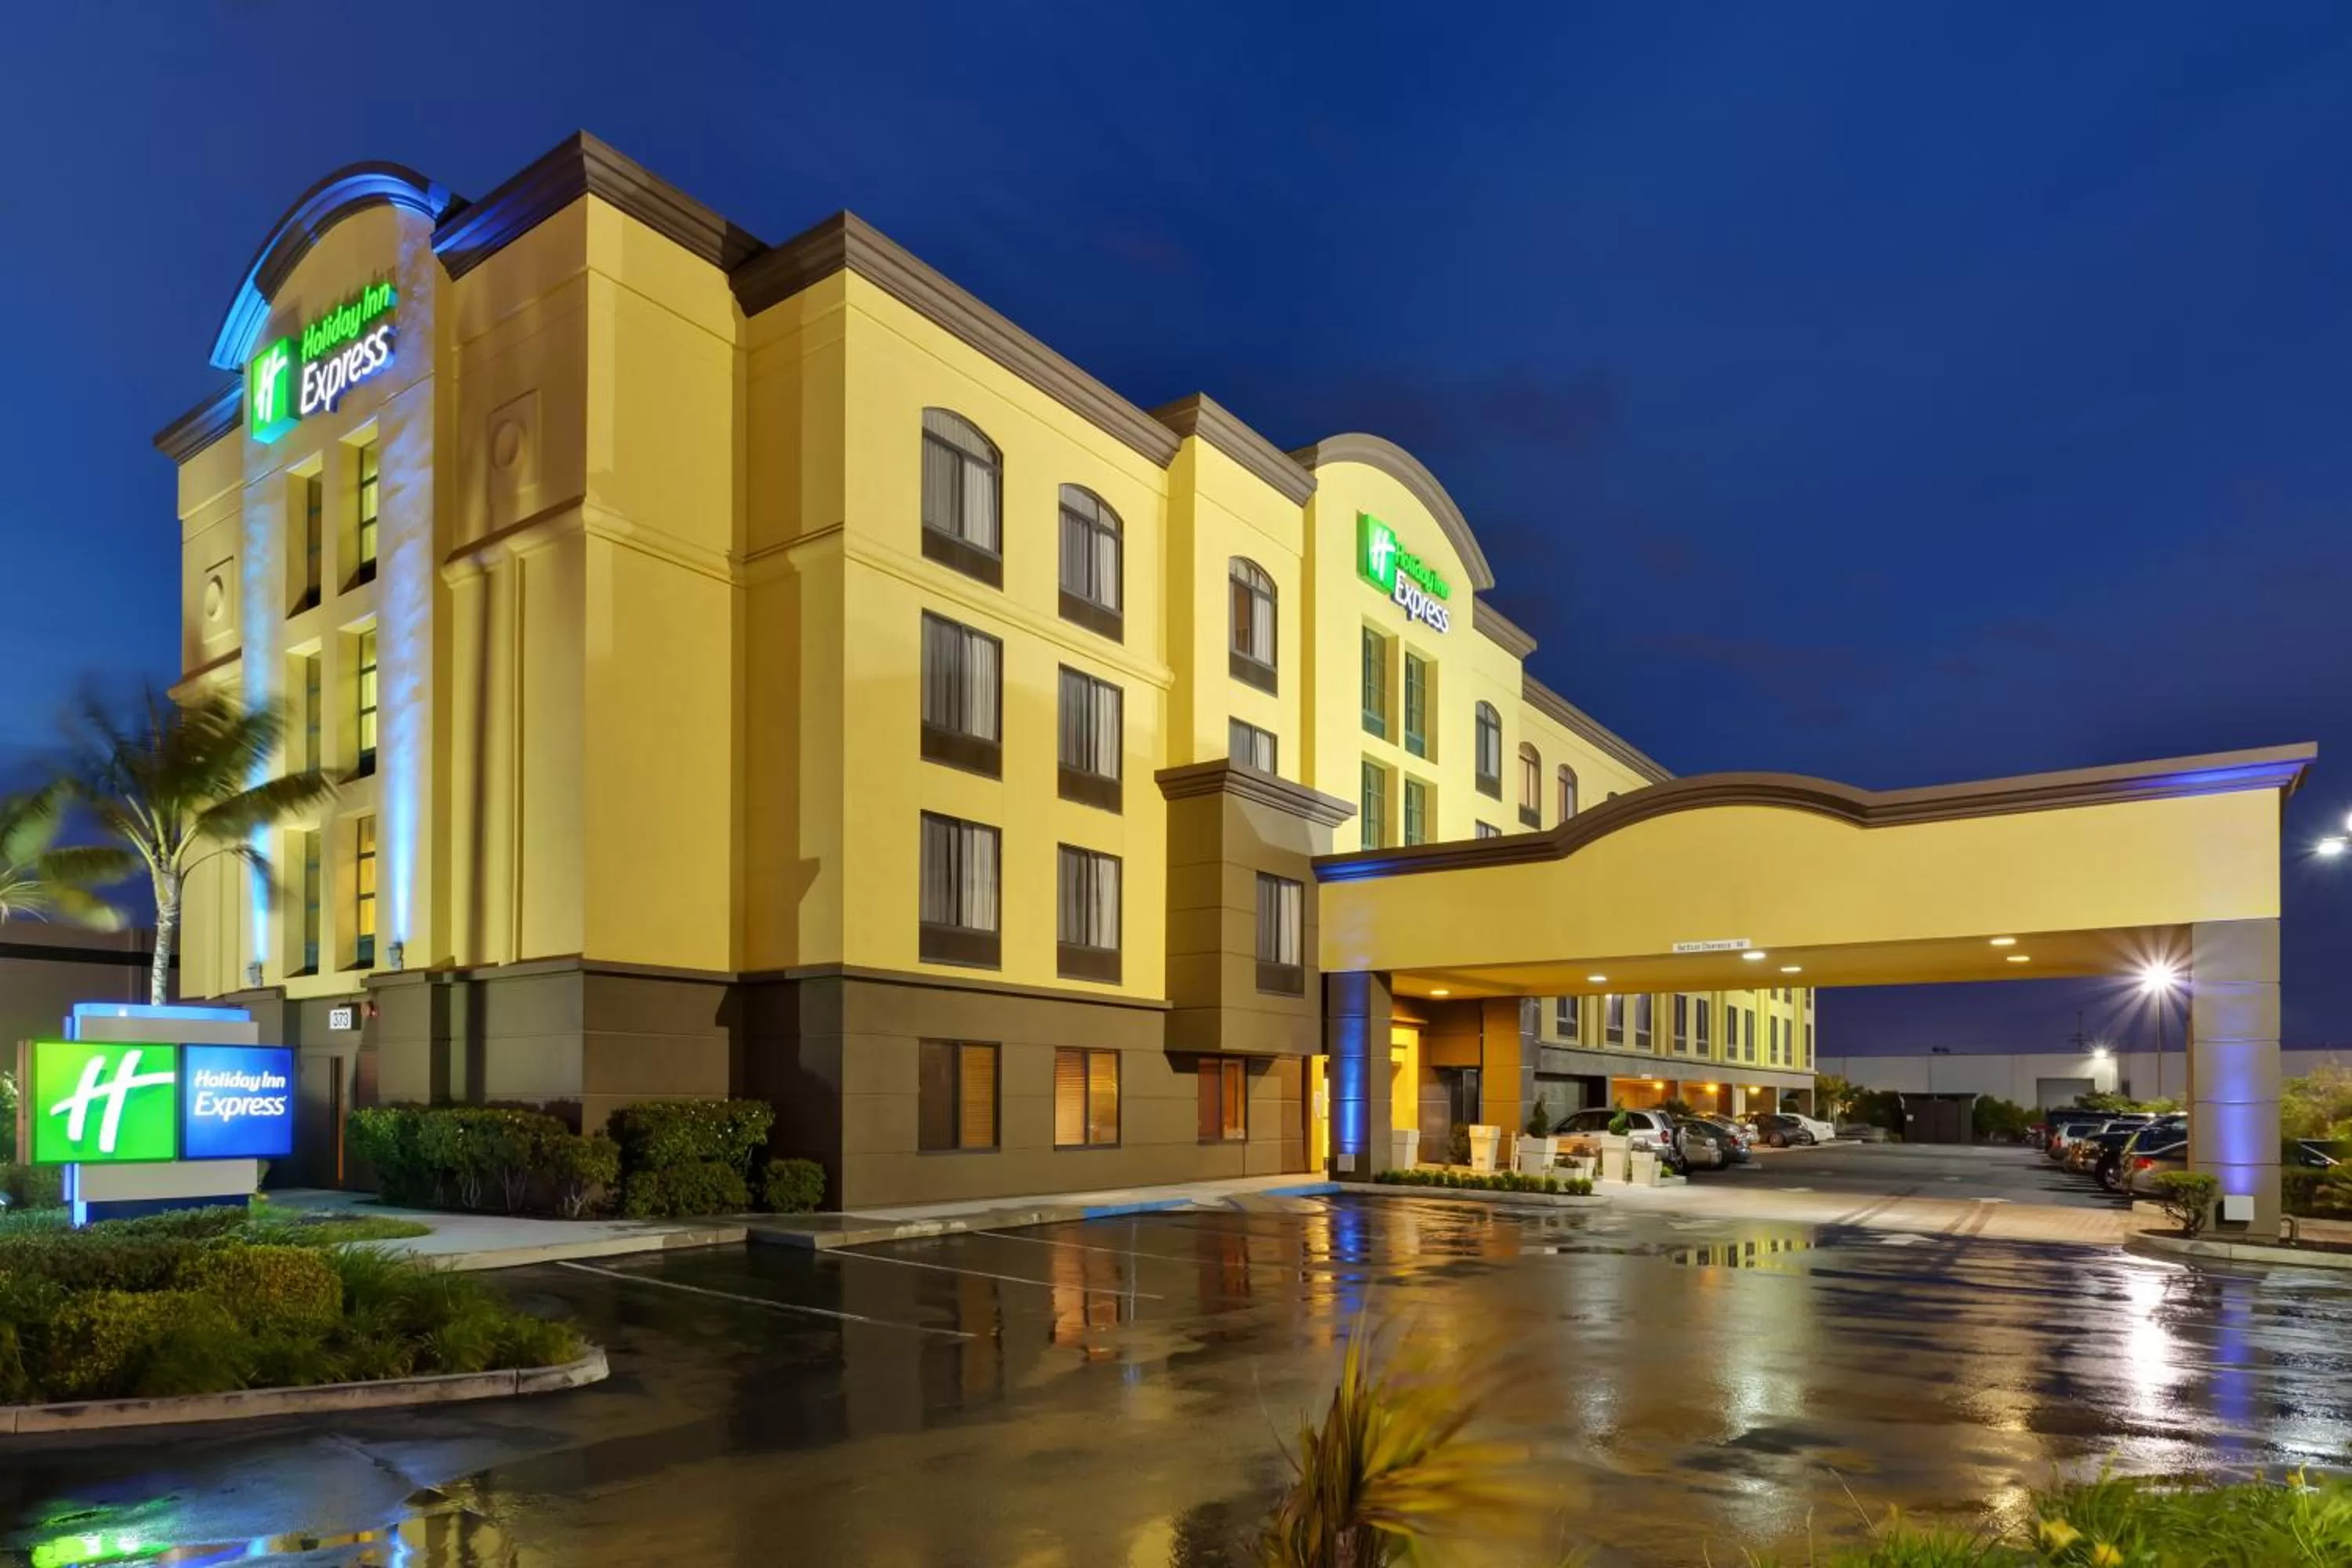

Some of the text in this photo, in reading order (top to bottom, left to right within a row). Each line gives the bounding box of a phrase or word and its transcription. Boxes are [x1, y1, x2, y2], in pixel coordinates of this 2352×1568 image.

[301, 283, 390, 362] Holiday Inn
[300, 325, 389, 414] Express
[1395, 568, 1450, 633] Express
[332, 1011, 349, 1027] 373
[194, 1069, 286, 1092] Holiday Inn
[194, 1091, 288, 1122] Express
